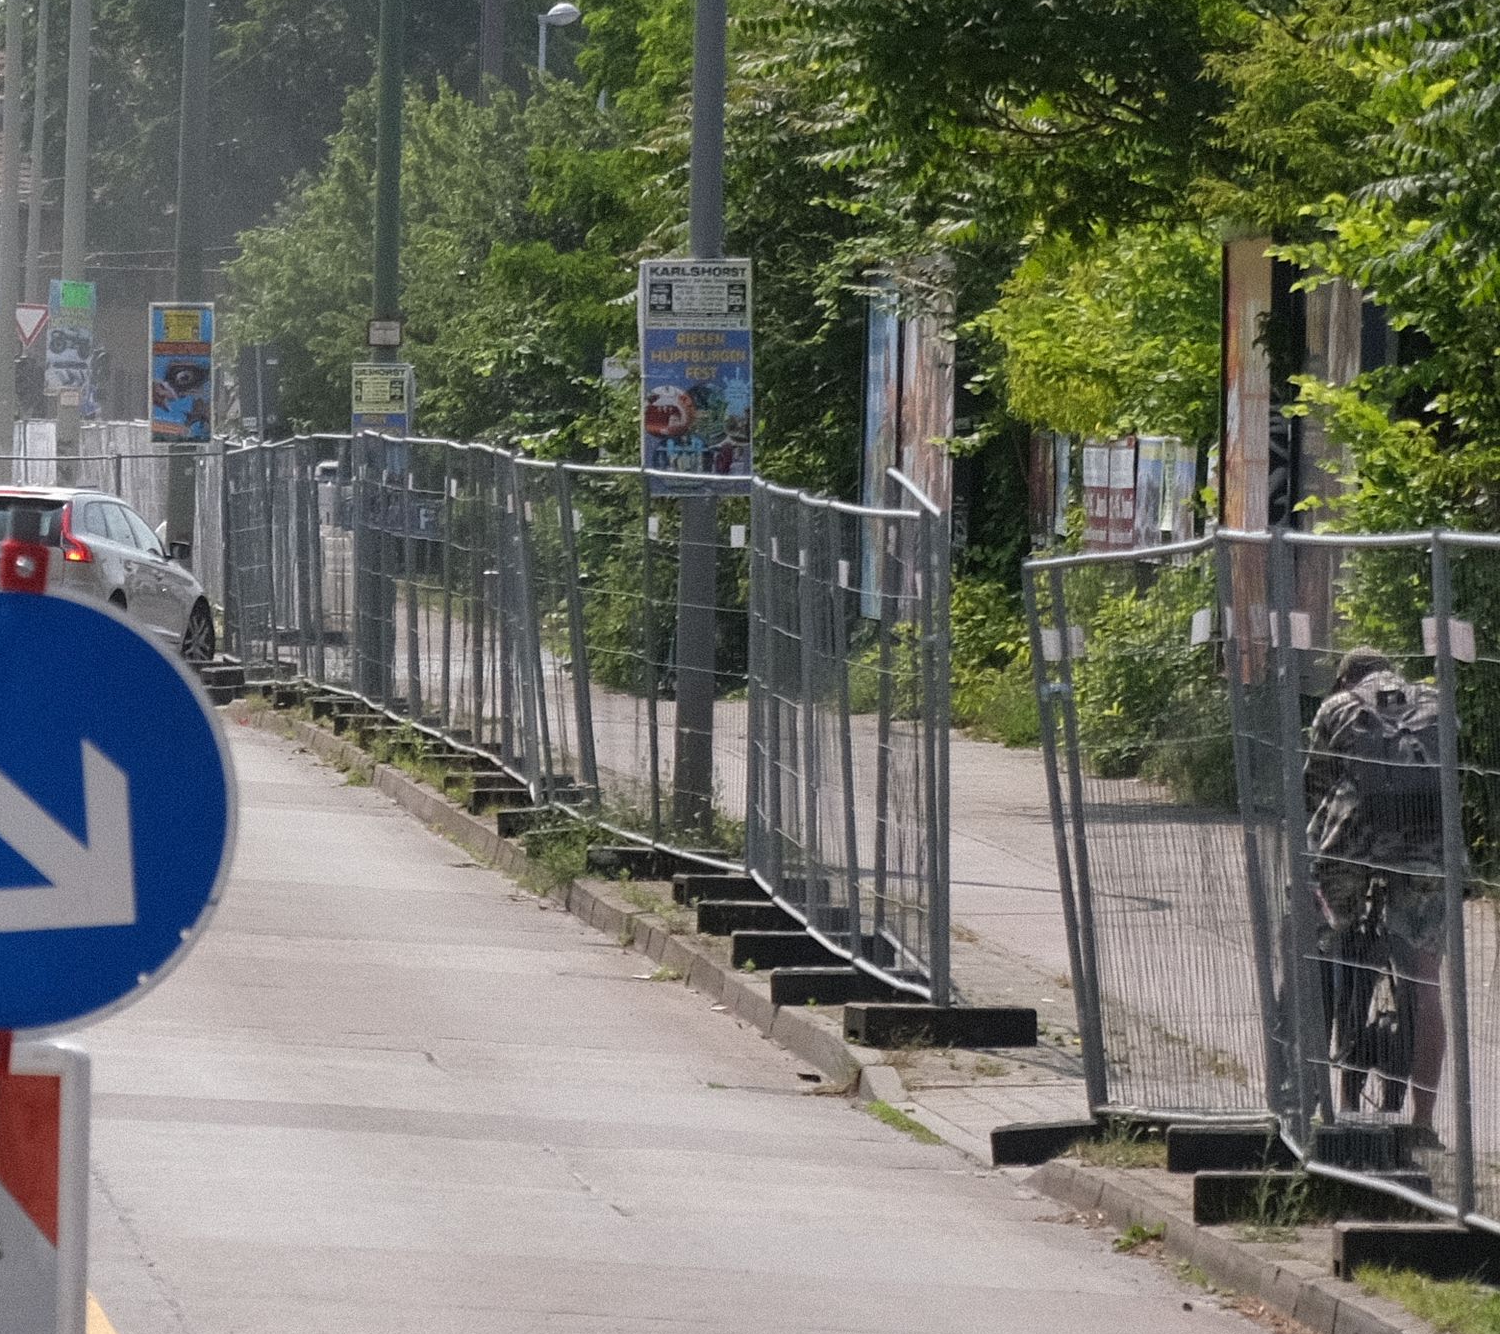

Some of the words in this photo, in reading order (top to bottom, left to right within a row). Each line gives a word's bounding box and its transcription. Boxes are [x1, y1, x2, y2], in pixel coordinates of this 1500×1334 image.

[650, 266, 747, 277] KARLSHORST
[675, 332, 726, 345] RIESEN
[685, 366, 718, 379] FEST
